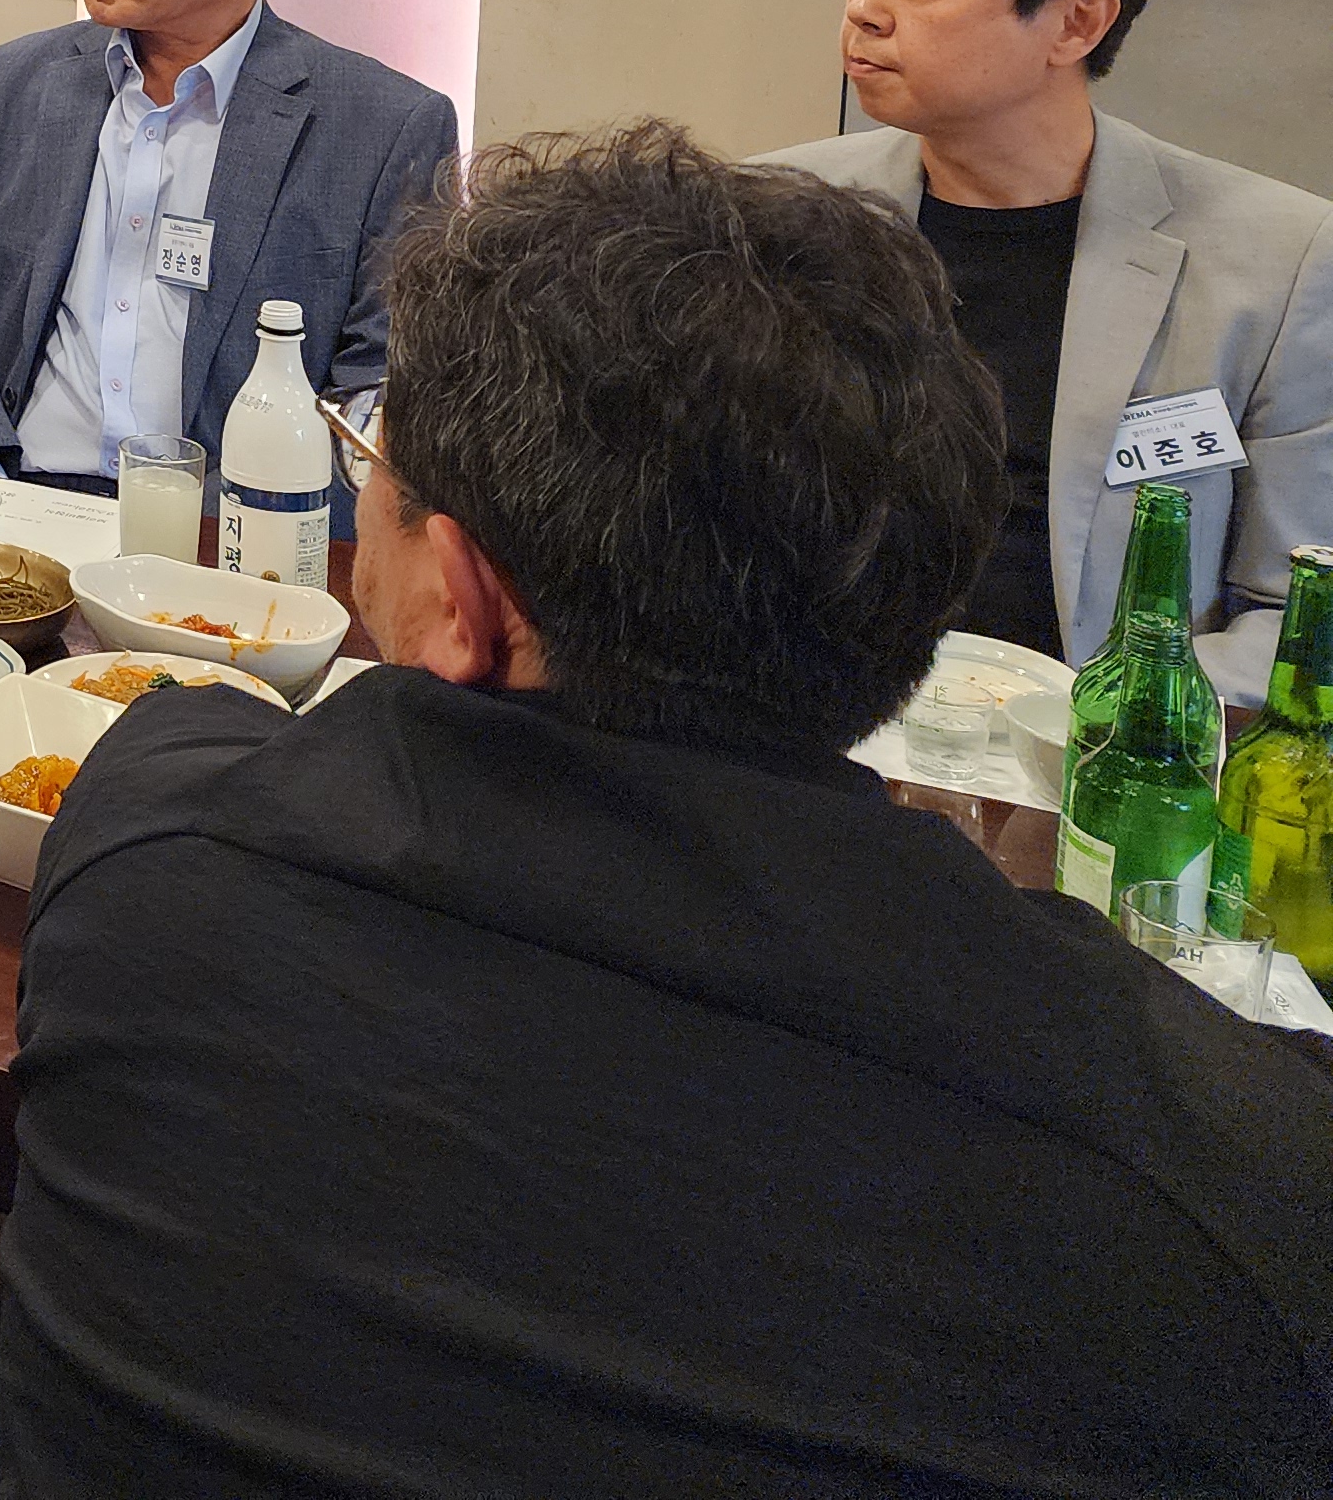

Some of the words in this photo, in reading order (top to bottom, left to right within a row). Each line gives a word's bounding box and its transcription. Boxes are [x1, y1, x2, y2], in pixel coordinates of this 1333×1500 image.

[162, 248, 202, 276] 장순영
[1121, 409, 1152, 423] REMA
[1116, 430, 1226, 472] 이준호
